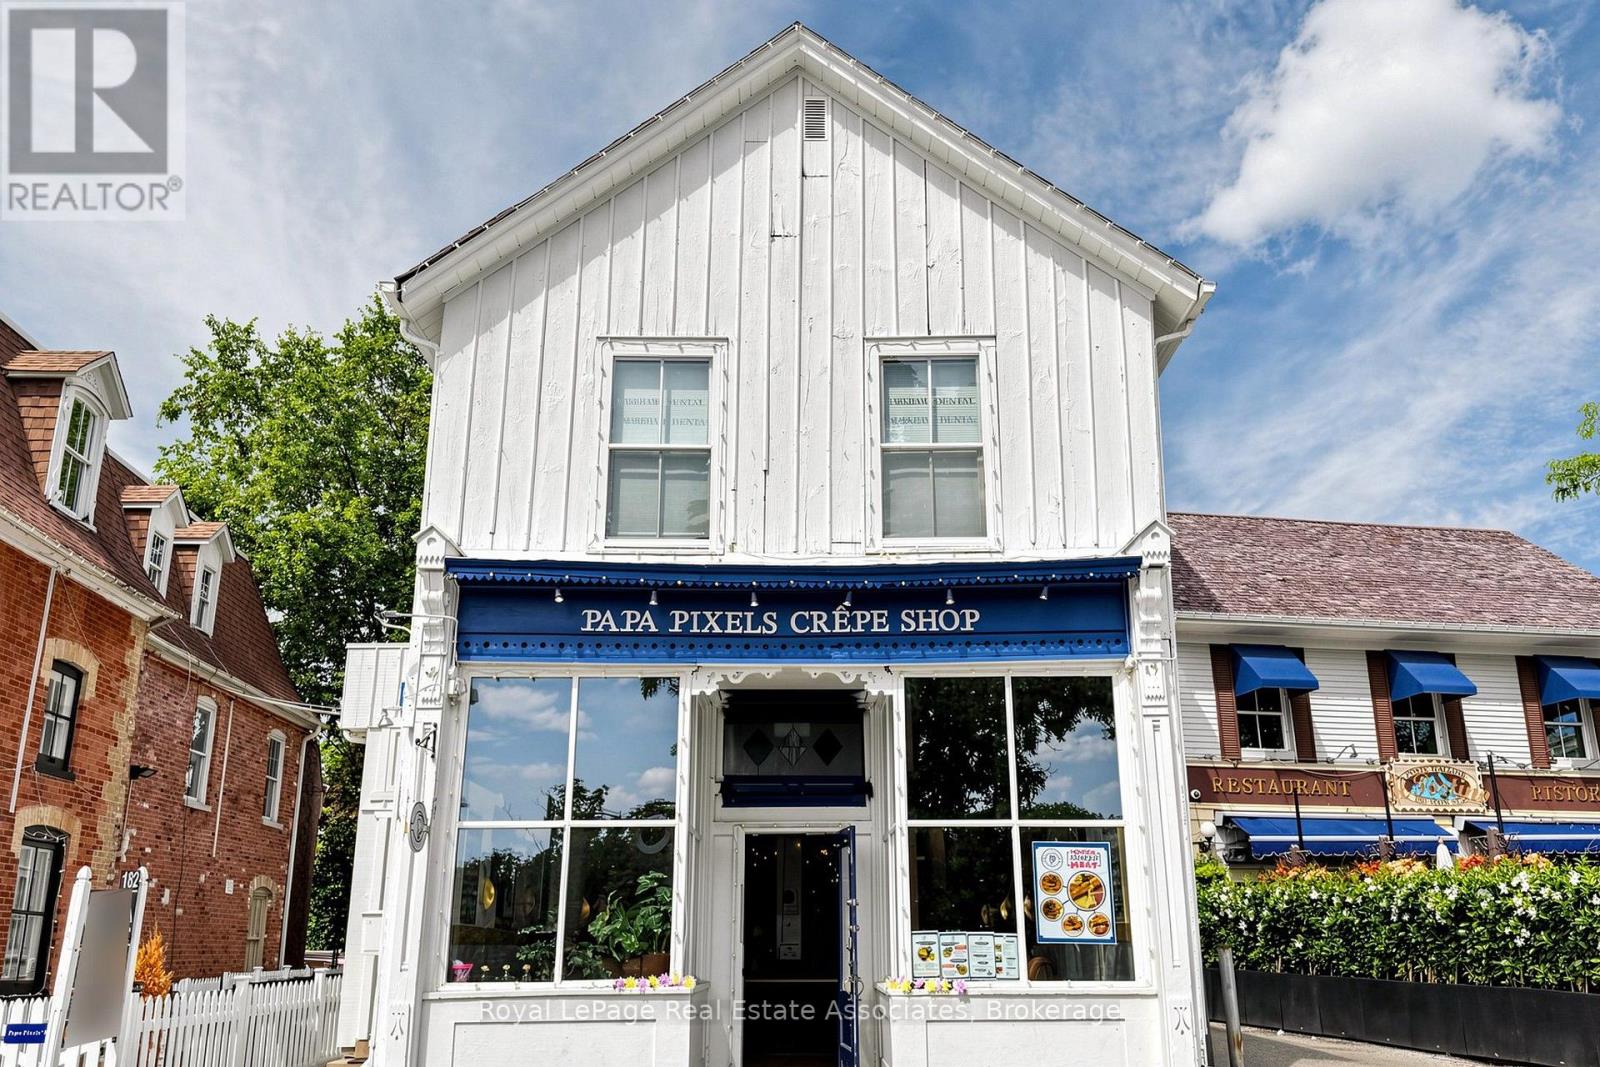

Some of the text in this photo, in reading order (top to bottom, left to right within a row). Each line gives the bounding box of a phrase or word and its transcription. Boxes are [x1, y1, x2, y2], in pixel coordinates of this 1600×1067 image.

[581, 604, 981, 635] PAPA PIXELS CRÊPE SHOP
[1212, 777, 1351, 796] RESTAURANT
